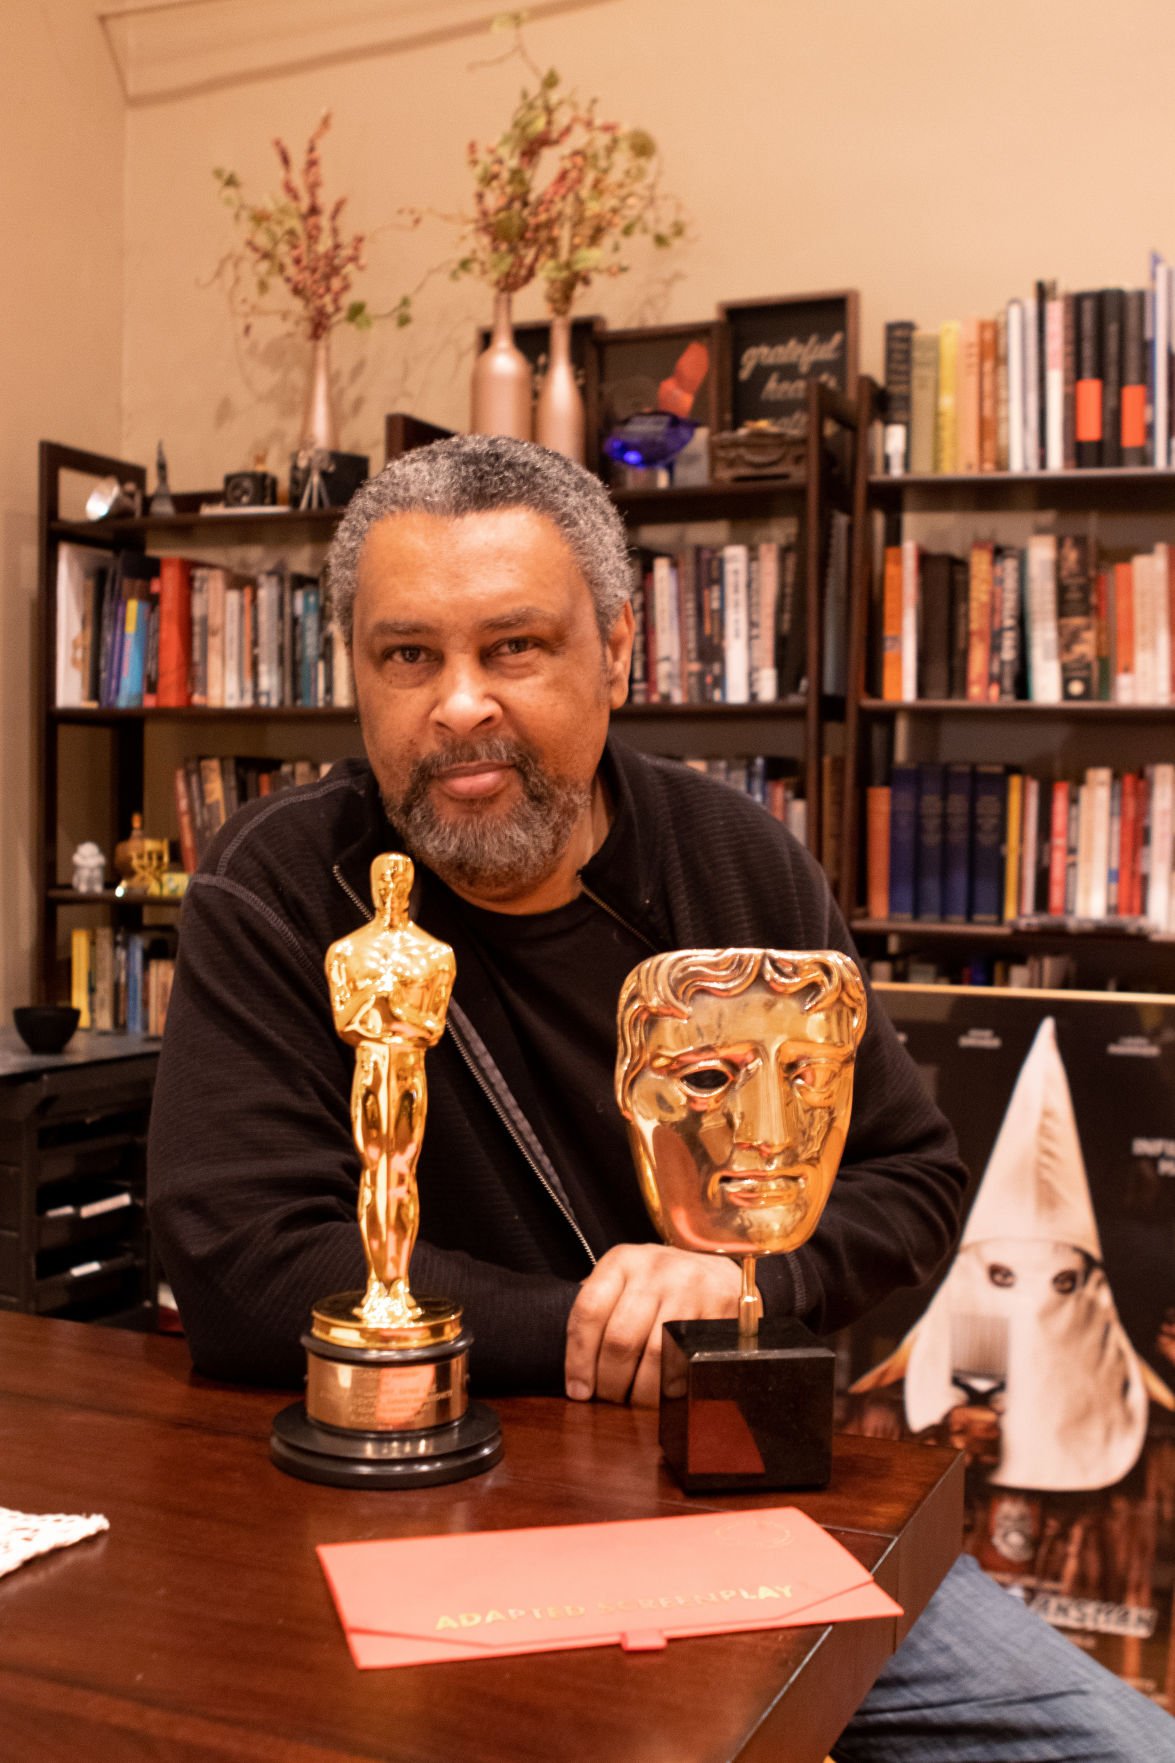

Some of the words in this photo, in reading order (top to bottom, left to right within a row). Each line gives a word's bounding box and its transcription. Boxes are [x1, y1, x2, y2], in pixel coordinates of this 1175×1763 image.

[738, 331, 843, 380] grateful
[434, 1605, 586, 1631] ADAPTED
[597, 1585, 793, 1614] SCREENPLAY
